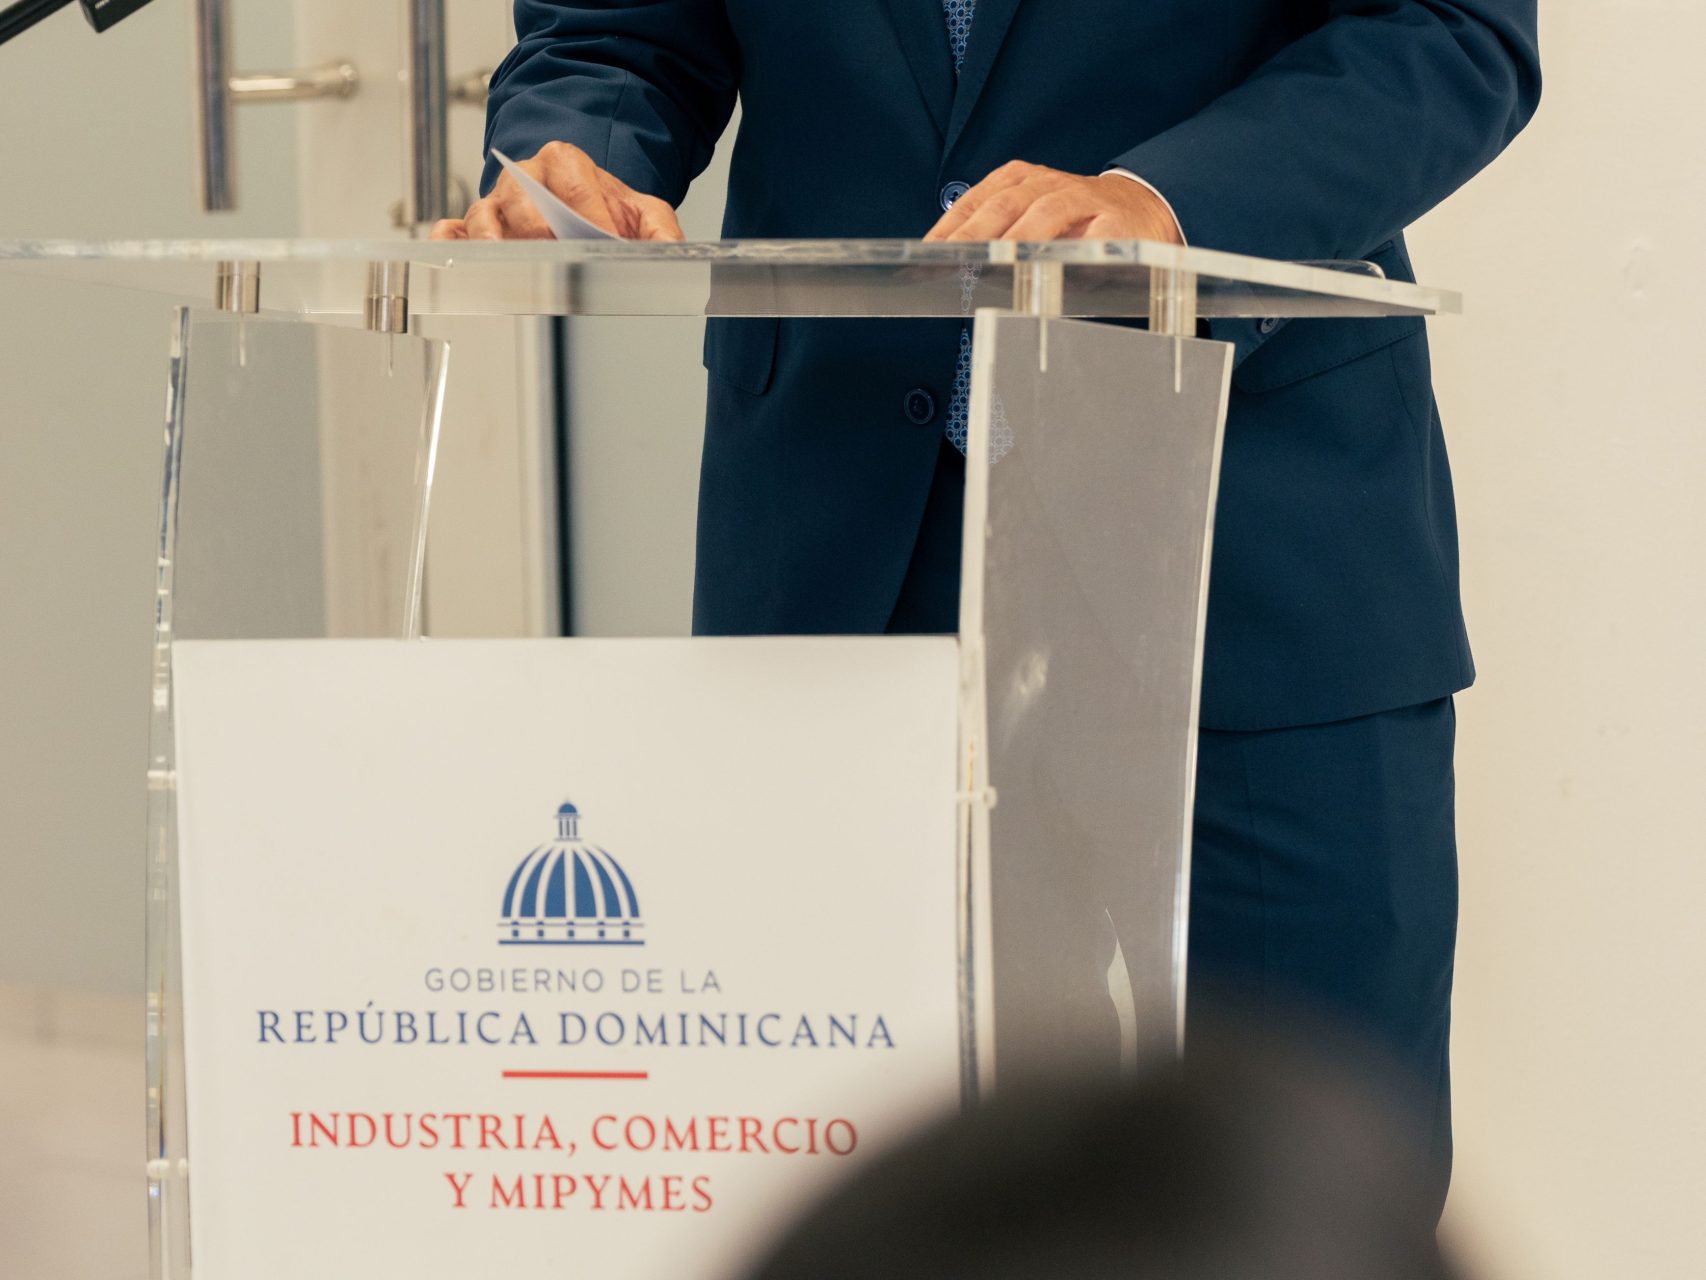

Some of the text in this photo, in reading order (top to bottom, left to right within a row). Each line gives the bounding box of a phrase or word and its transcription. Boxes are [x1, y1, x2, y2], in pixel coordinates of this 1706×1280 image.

[424, 967, 722, 994] GOBIERNO DE LA
[256, 1001, 896, 1049] REPÚBLICA DOMINICANA
[290, 1111, 859, 1157] INDUSTRIA, COMERCIO
[443, 1172, 714, 1213] Y MIPYMES
